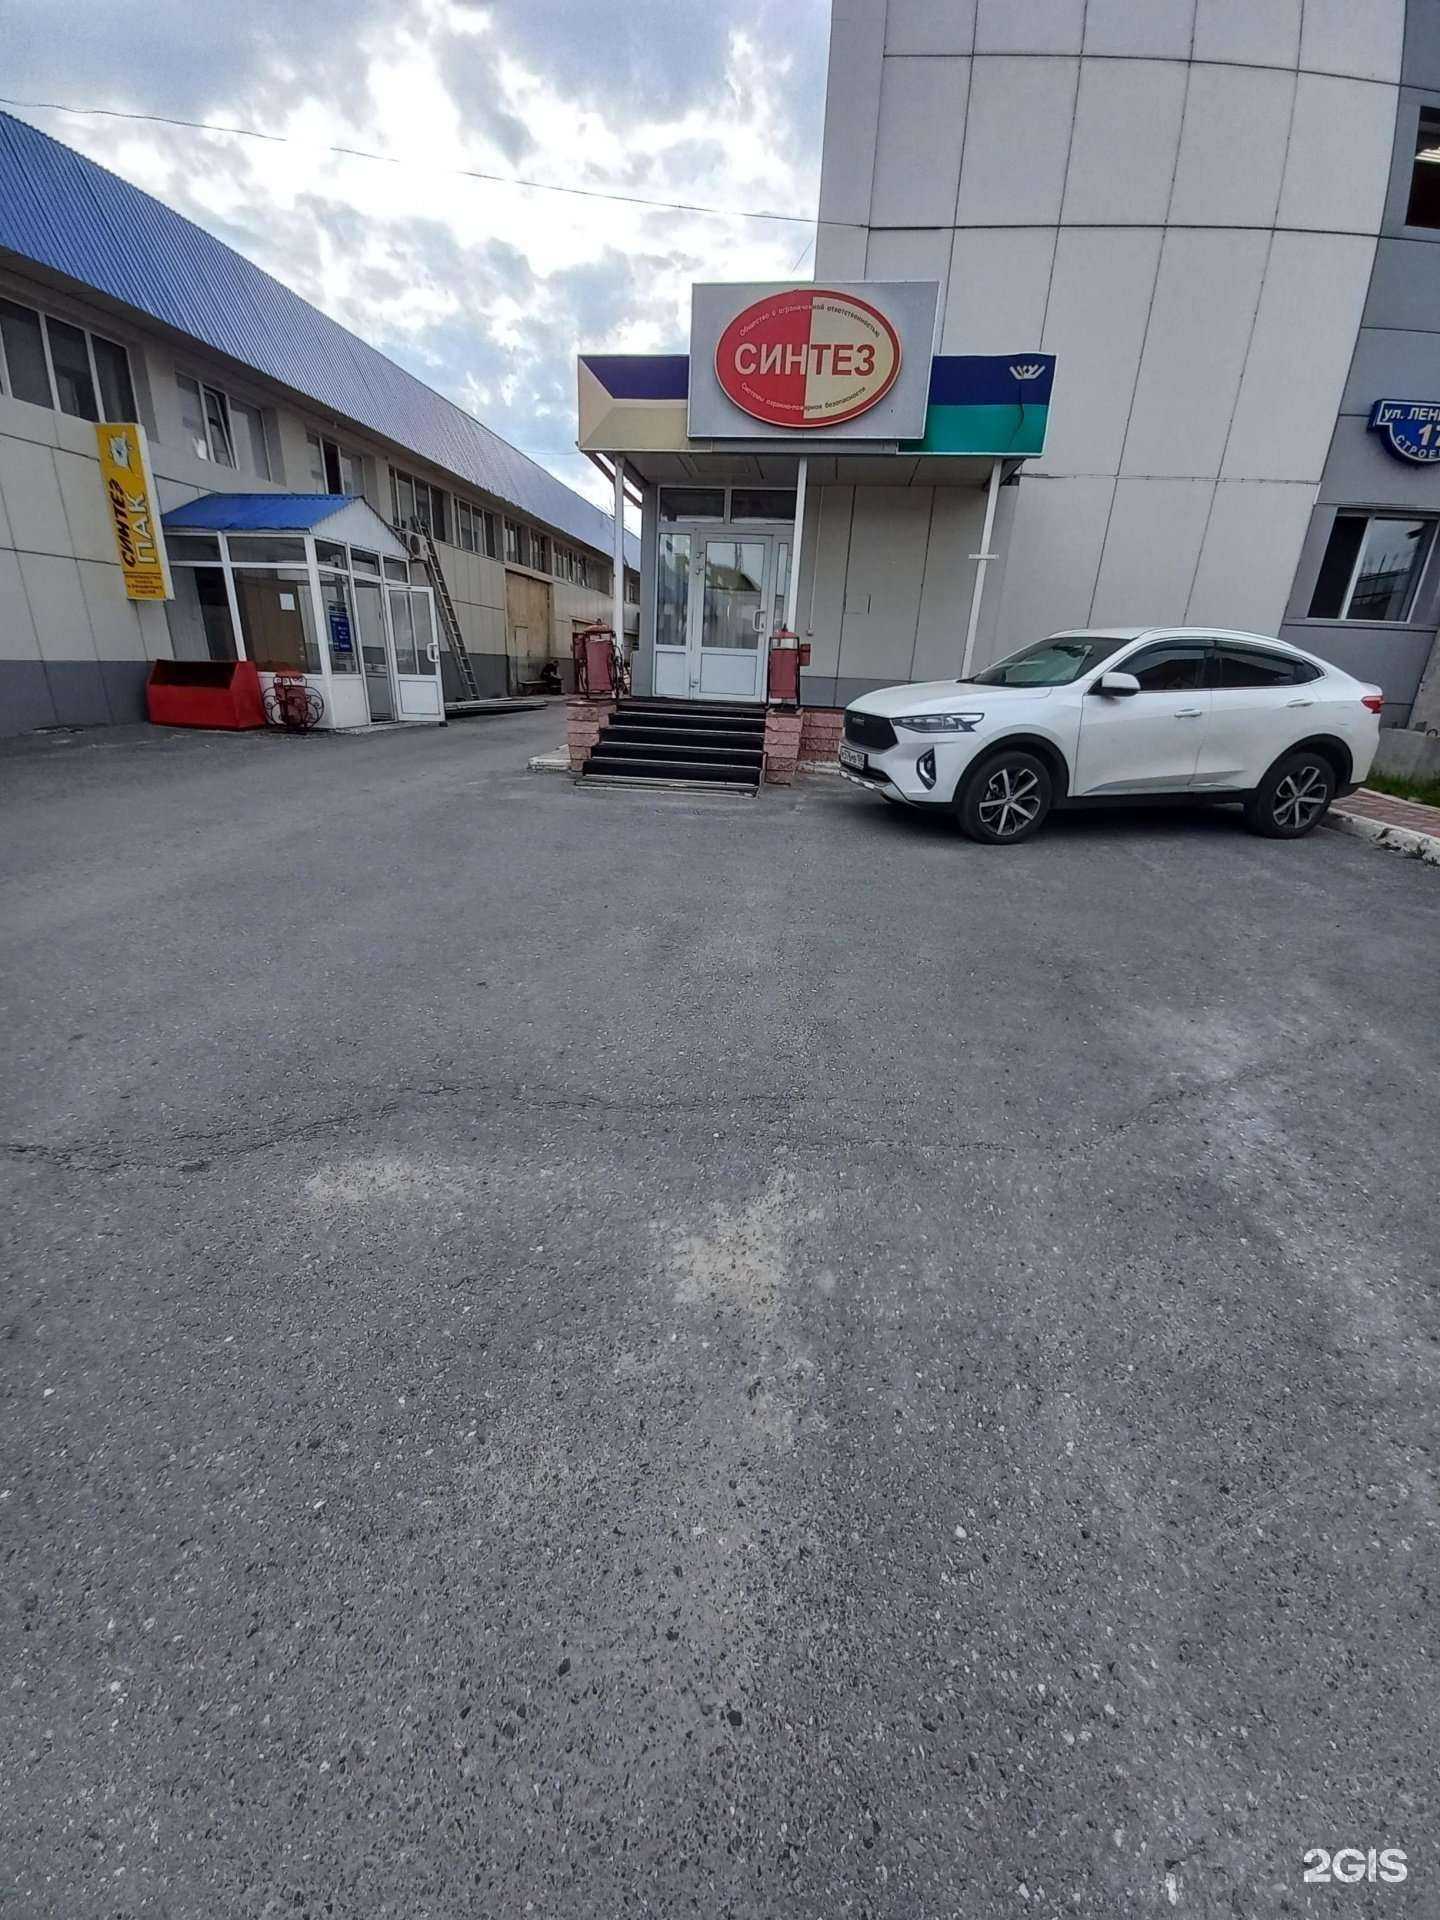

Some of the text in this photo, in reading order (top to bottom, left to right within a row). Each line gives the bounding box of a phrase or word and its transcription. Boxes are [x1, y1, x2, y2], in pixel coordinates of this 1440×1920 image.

[827, 305, 880, 338] ответственностью
[735, 343, 877, 377] СИНТЕЗ
[825, 387, 866, 408] безопасности
[1383, 407, 1440, 421] ул. ЛЕН
[1396, 435, 1440, 459] СТРОЕ
[109, 478, 137, 567] СИНТЕЗ
[126, 492, 157, 564] ПАК
